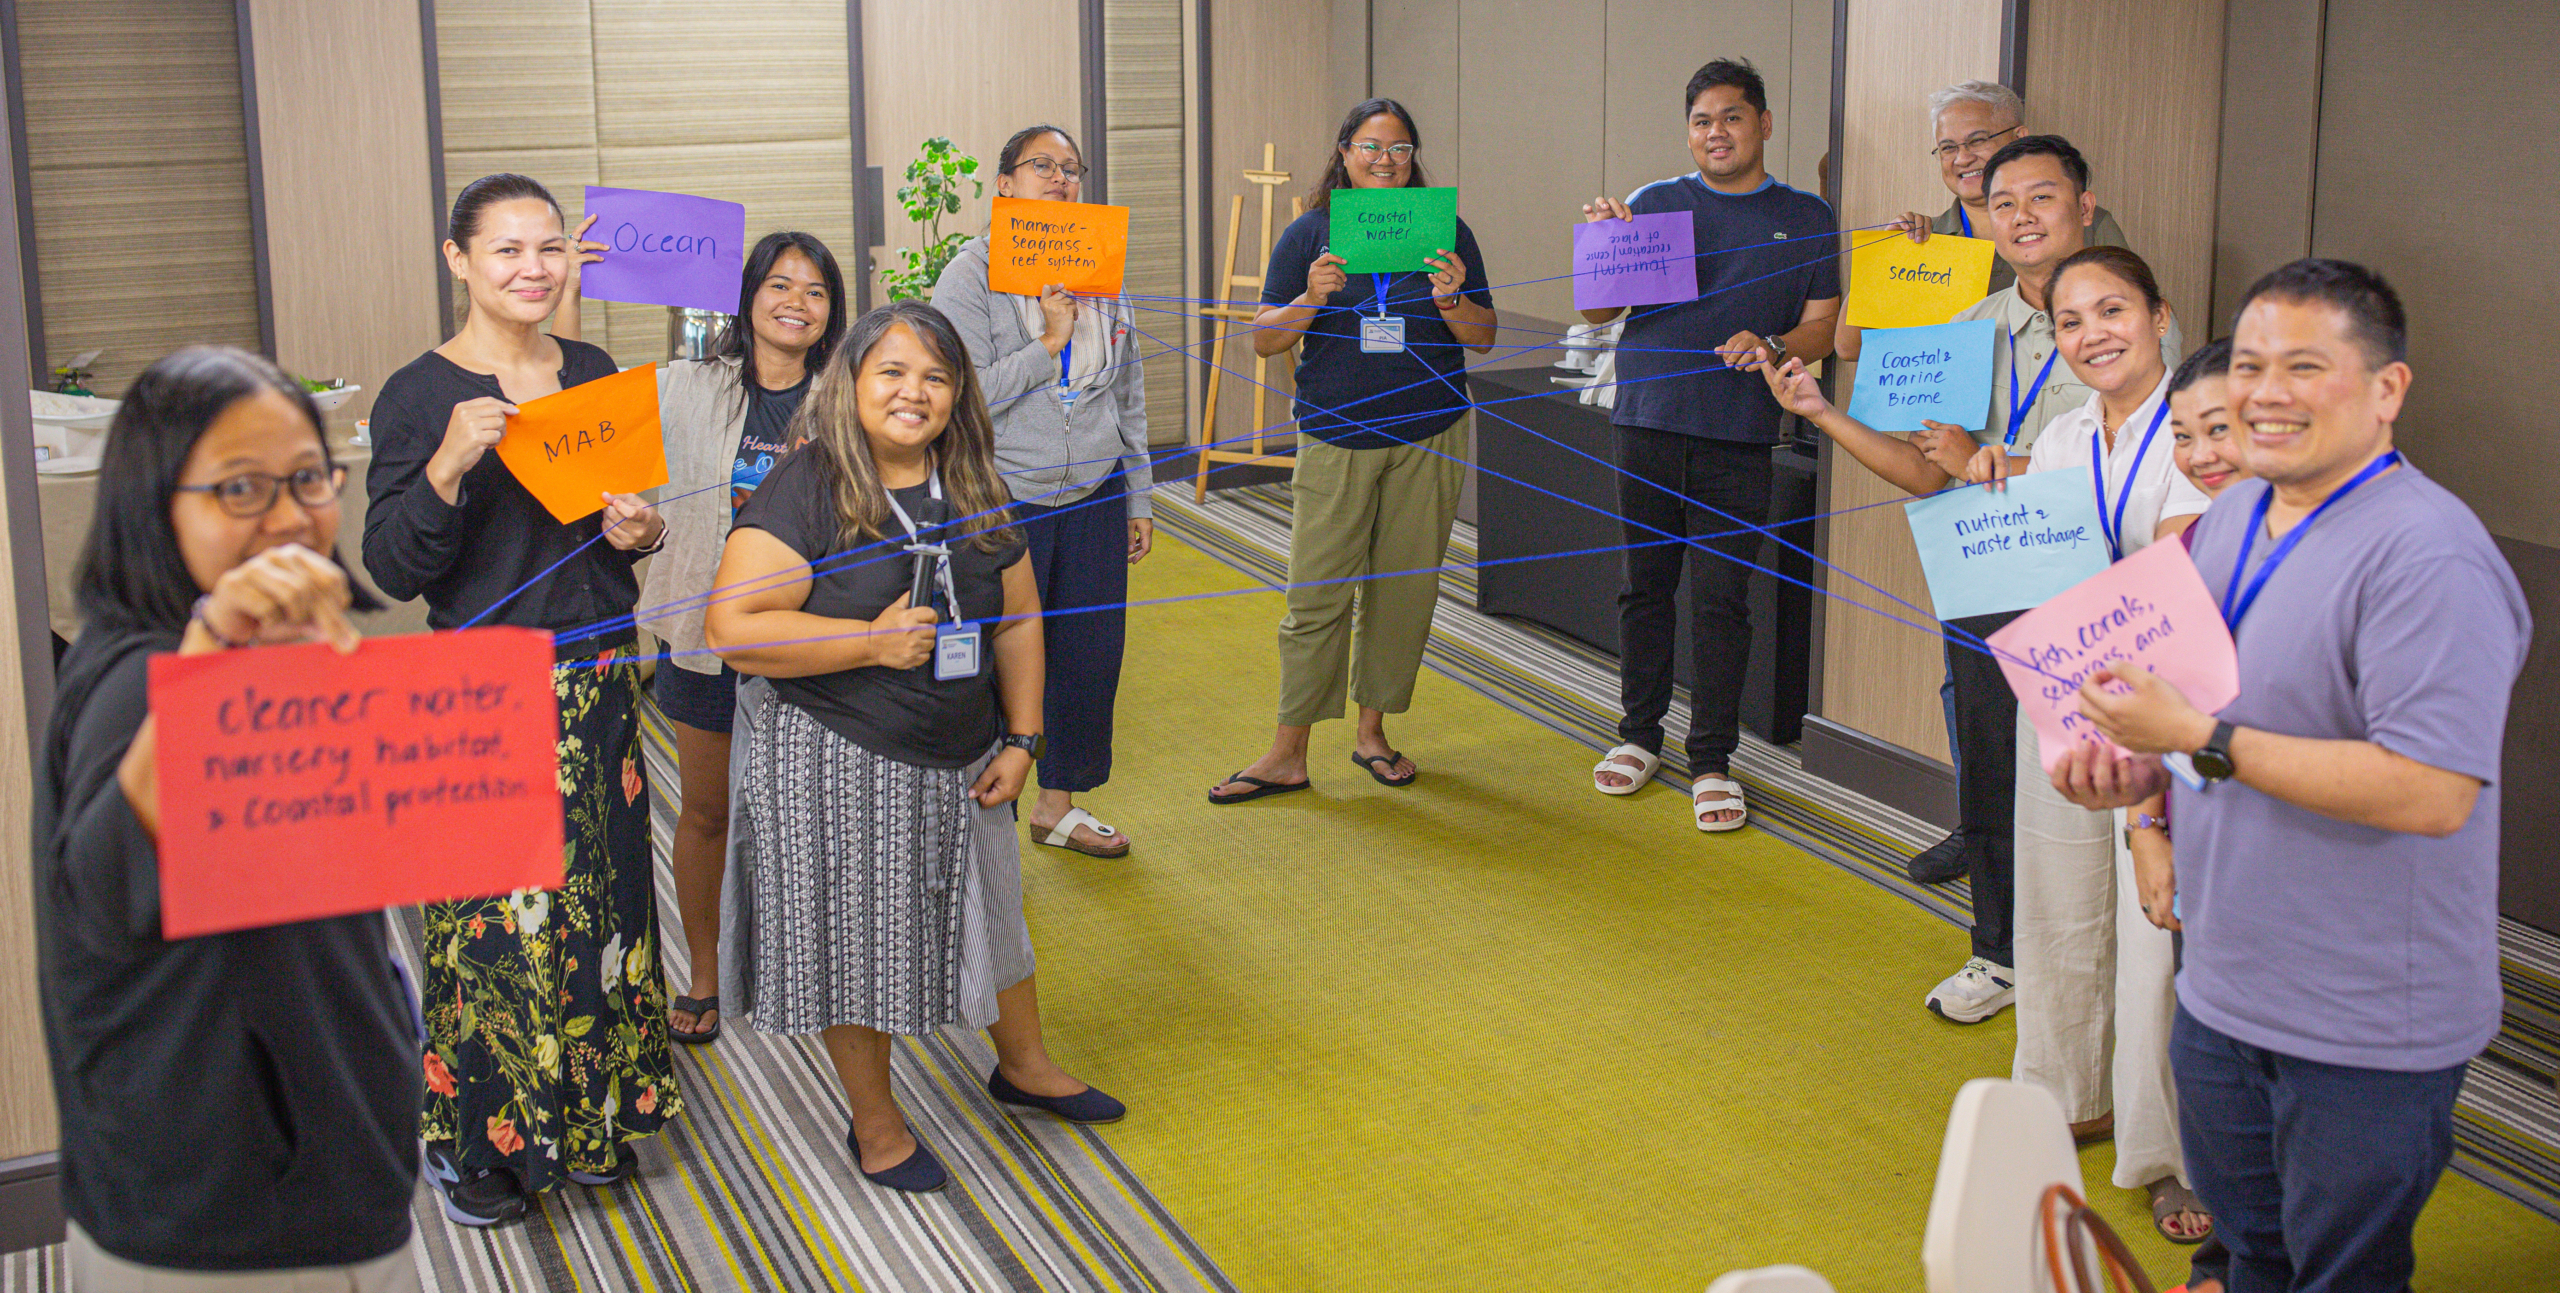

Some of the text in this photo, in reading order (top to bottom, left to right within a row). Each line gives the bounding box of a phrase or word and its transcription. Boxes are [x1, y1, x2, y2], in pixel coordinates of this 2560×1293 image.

[614, 222, 716, 259] Ocean
[1366, 226, 1412, 240] water
[1608, 230, 1660, 244] of place
[1011, 253, 1096, 272] reef system
[1889, 262, 1952, 287] seafood
[1888, 391, 1943, 407] Biome
[543, 420, 616, 463] MAB
[742, 435, 788, 454] Heart
[1954, 503, 2030, 536] nutrient
[1961, 525, 2091, 559] waste discharge
[2135, 613, 2175, 652] and
[946, 651, 967, 660] KAREN
[204, 746, 351, 786] nursery
[384, 775, 529, 827] protection
